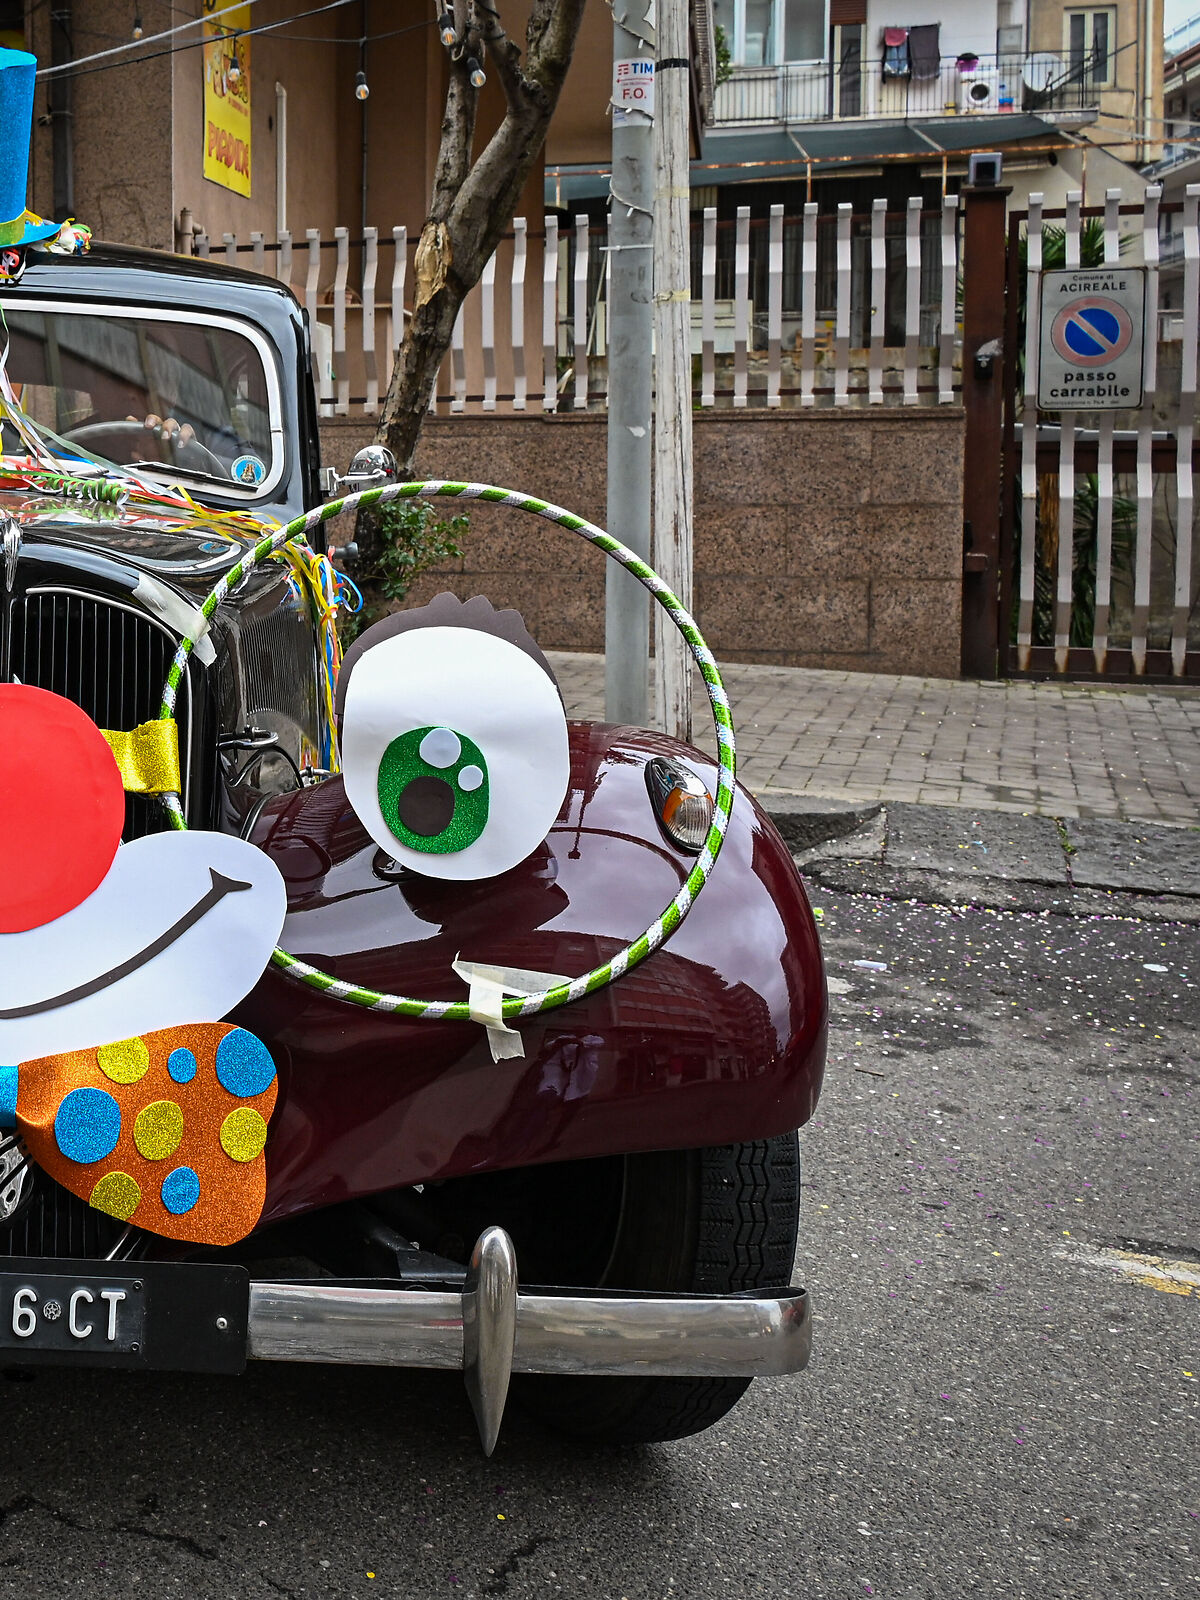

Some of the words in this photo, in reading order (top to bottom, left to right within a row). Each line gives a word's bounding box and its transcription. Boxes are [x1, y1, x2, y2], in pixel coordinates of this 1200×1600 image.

[631, 62, 653, 74] TIM
[622, 87, 647, 99] F.O.
[1060, 282, 1127, 292] ACIREALE
[1064, 372, 1117, 384] passo
[1050, 385, 1130, 398] carrabile
[68, 1288, 127, 1341] CT
